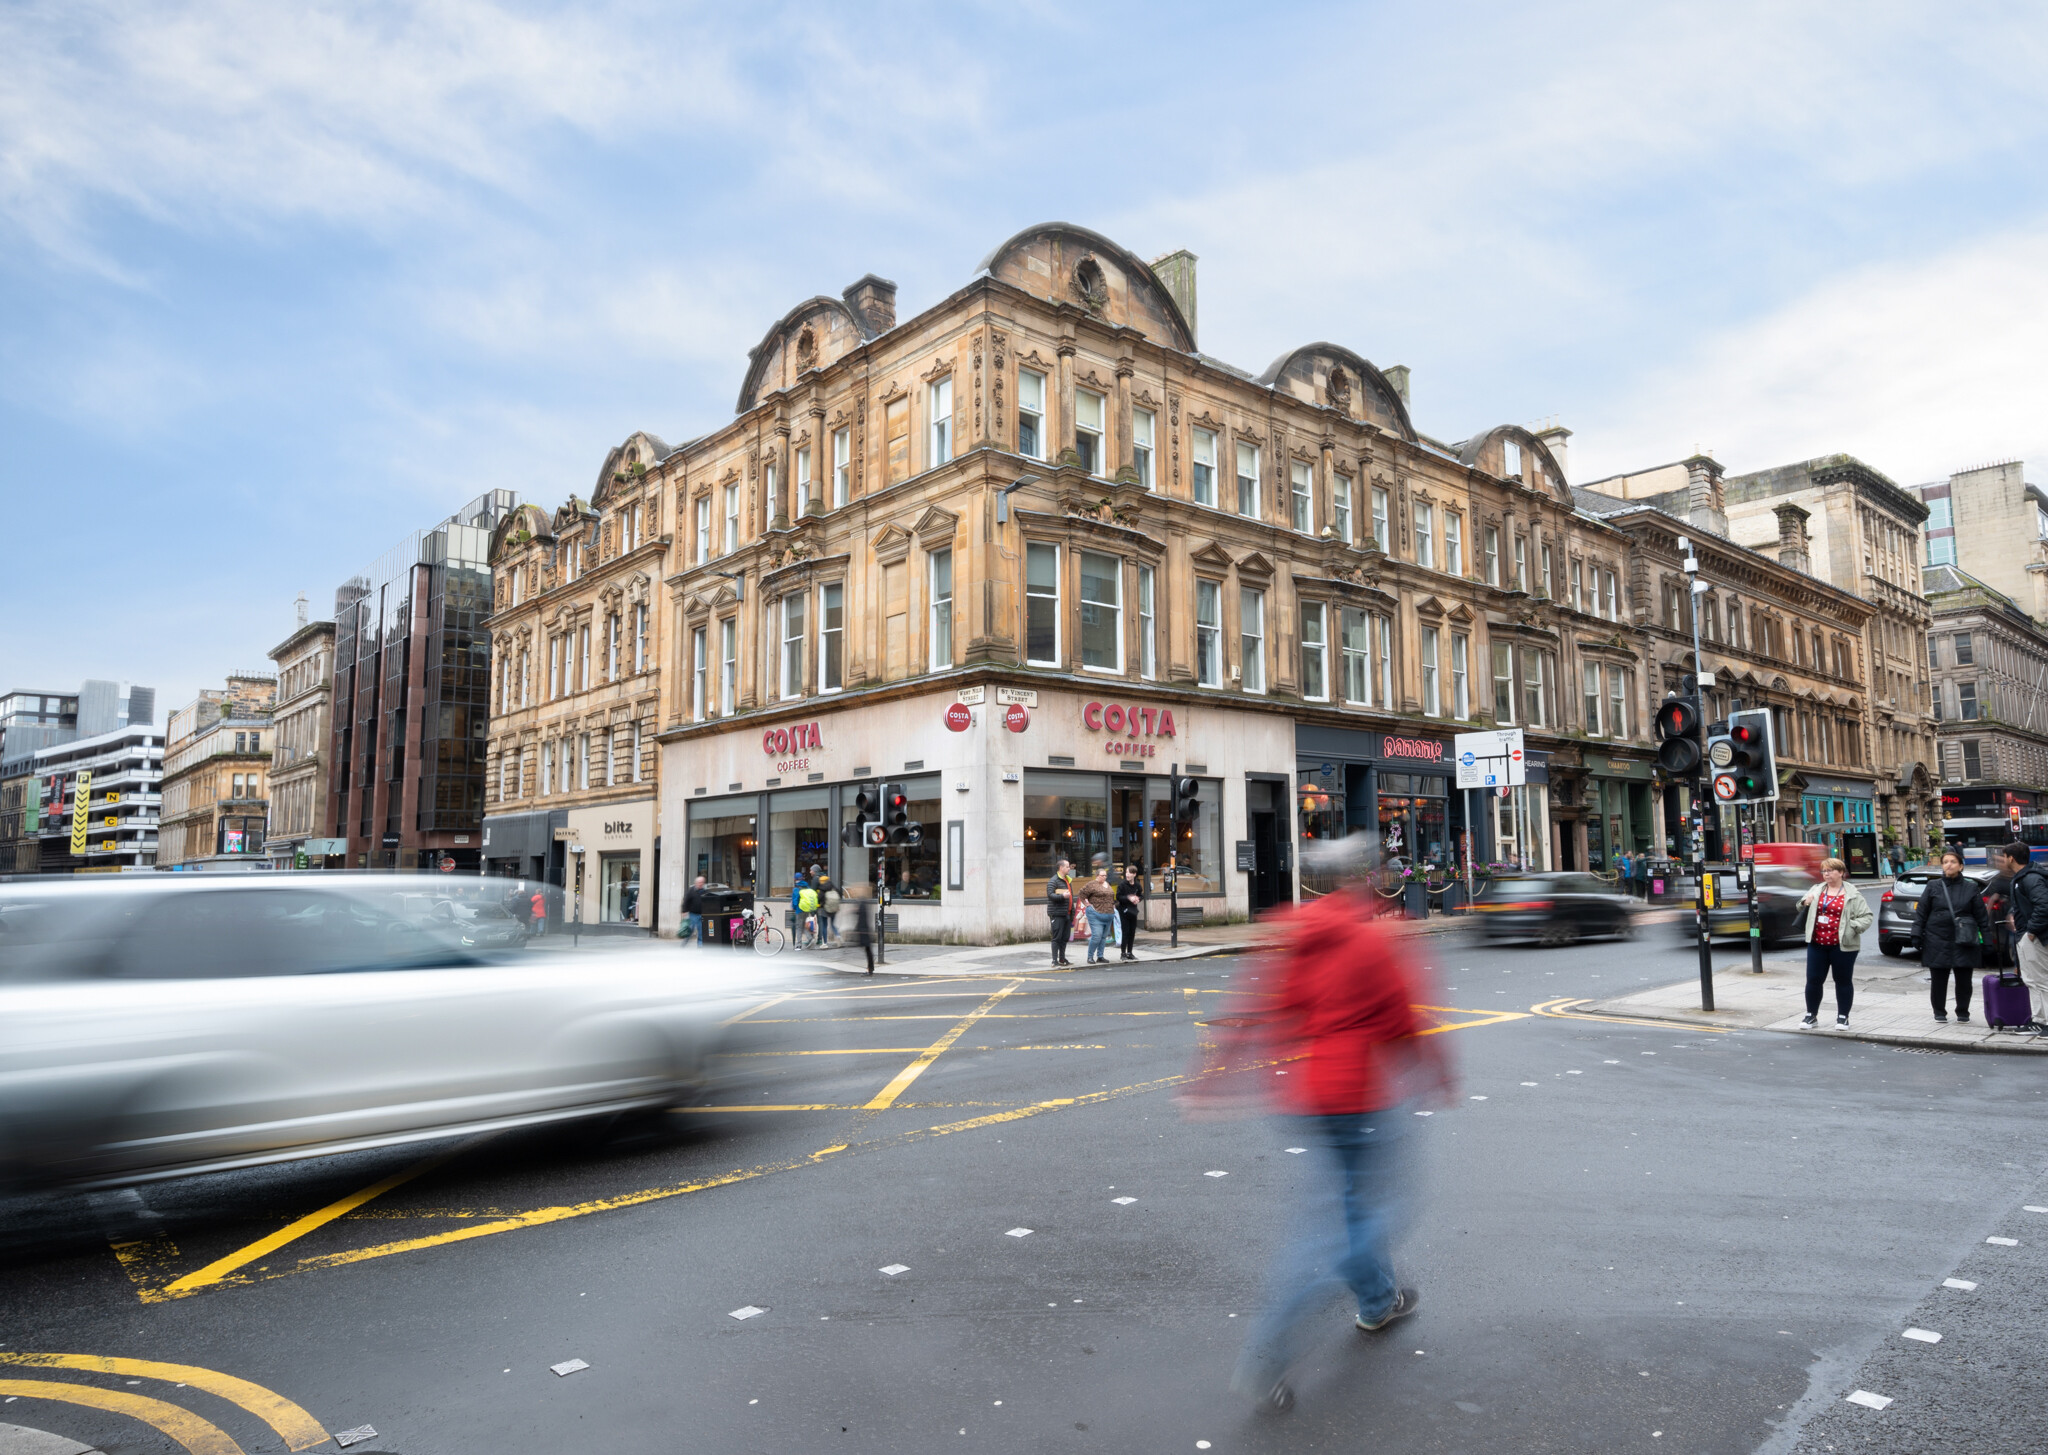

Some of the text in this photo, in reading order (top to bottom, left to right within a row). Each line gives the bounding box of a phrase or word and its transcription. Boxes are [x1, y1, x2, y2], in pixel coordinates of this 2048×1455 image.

[962, 694, 979, 702] STREET
[1007, 695, 1028, 703] STREET
[949, 711, 969, 720] COSTA
[1007, 712, 1024, 721] COSTA
[1082, 701, 1177, 738] COSTA
[762, 722, 824, 755] COSTA
[1104, 741, 1156, 757] COFFEE
[777, 758, 810, 772] COFFEE
[1486, 775, 1493, 785] P
[1940, 795, 1960, 804] Pho
[604, 821, 633, 834] blitz
[327, 841, 336, 852] 7
